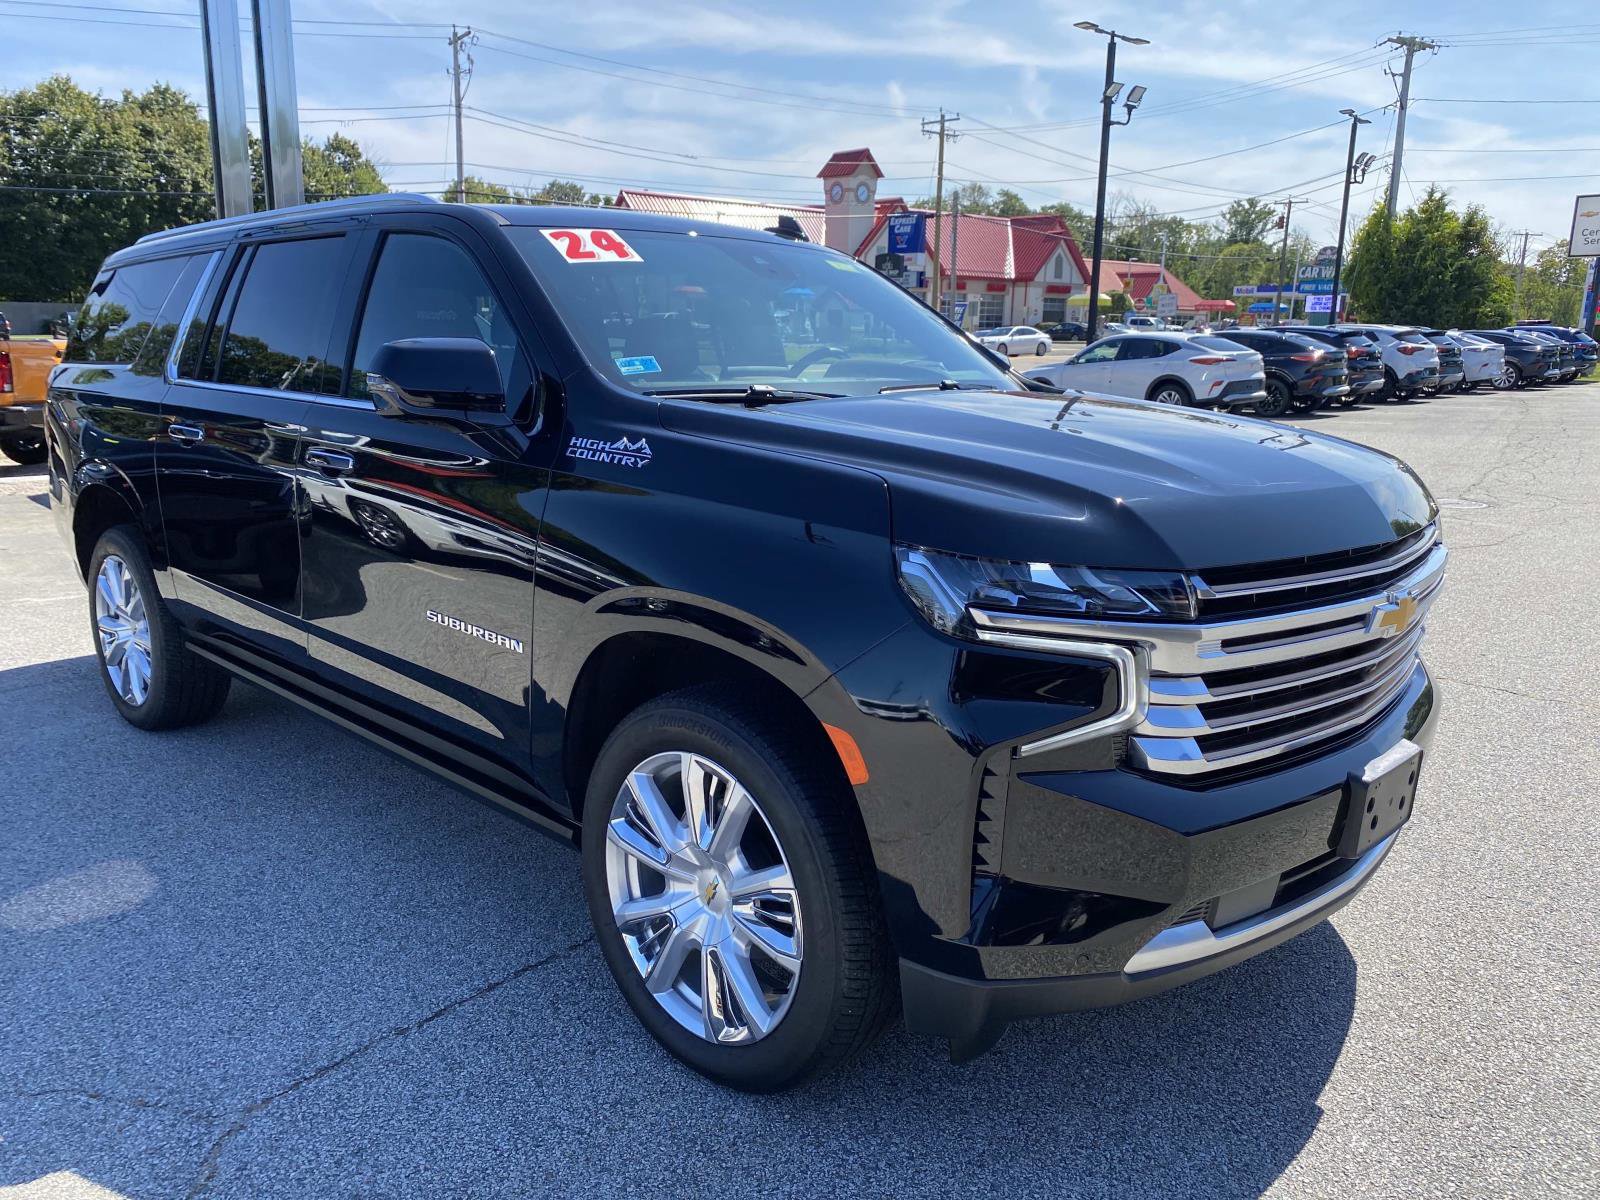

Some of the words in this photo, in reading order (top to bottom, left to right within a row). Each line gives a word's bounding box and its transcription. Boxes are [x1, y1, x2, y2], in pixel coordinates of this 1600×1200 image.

[890, 216, 917, 226] EXPRESS
[894, 225, 912, 233] CARE
[548, 230, 632, 261] 24
[1298, 266, 1320, 278] CAR
[569, 436, 611, 451] HIGH
[566, 448, 650, 468] COUNTRY
[426, 610, 524, 654] SUBURBAN
[656, 713, 734, 751] BRIDGESTONE
